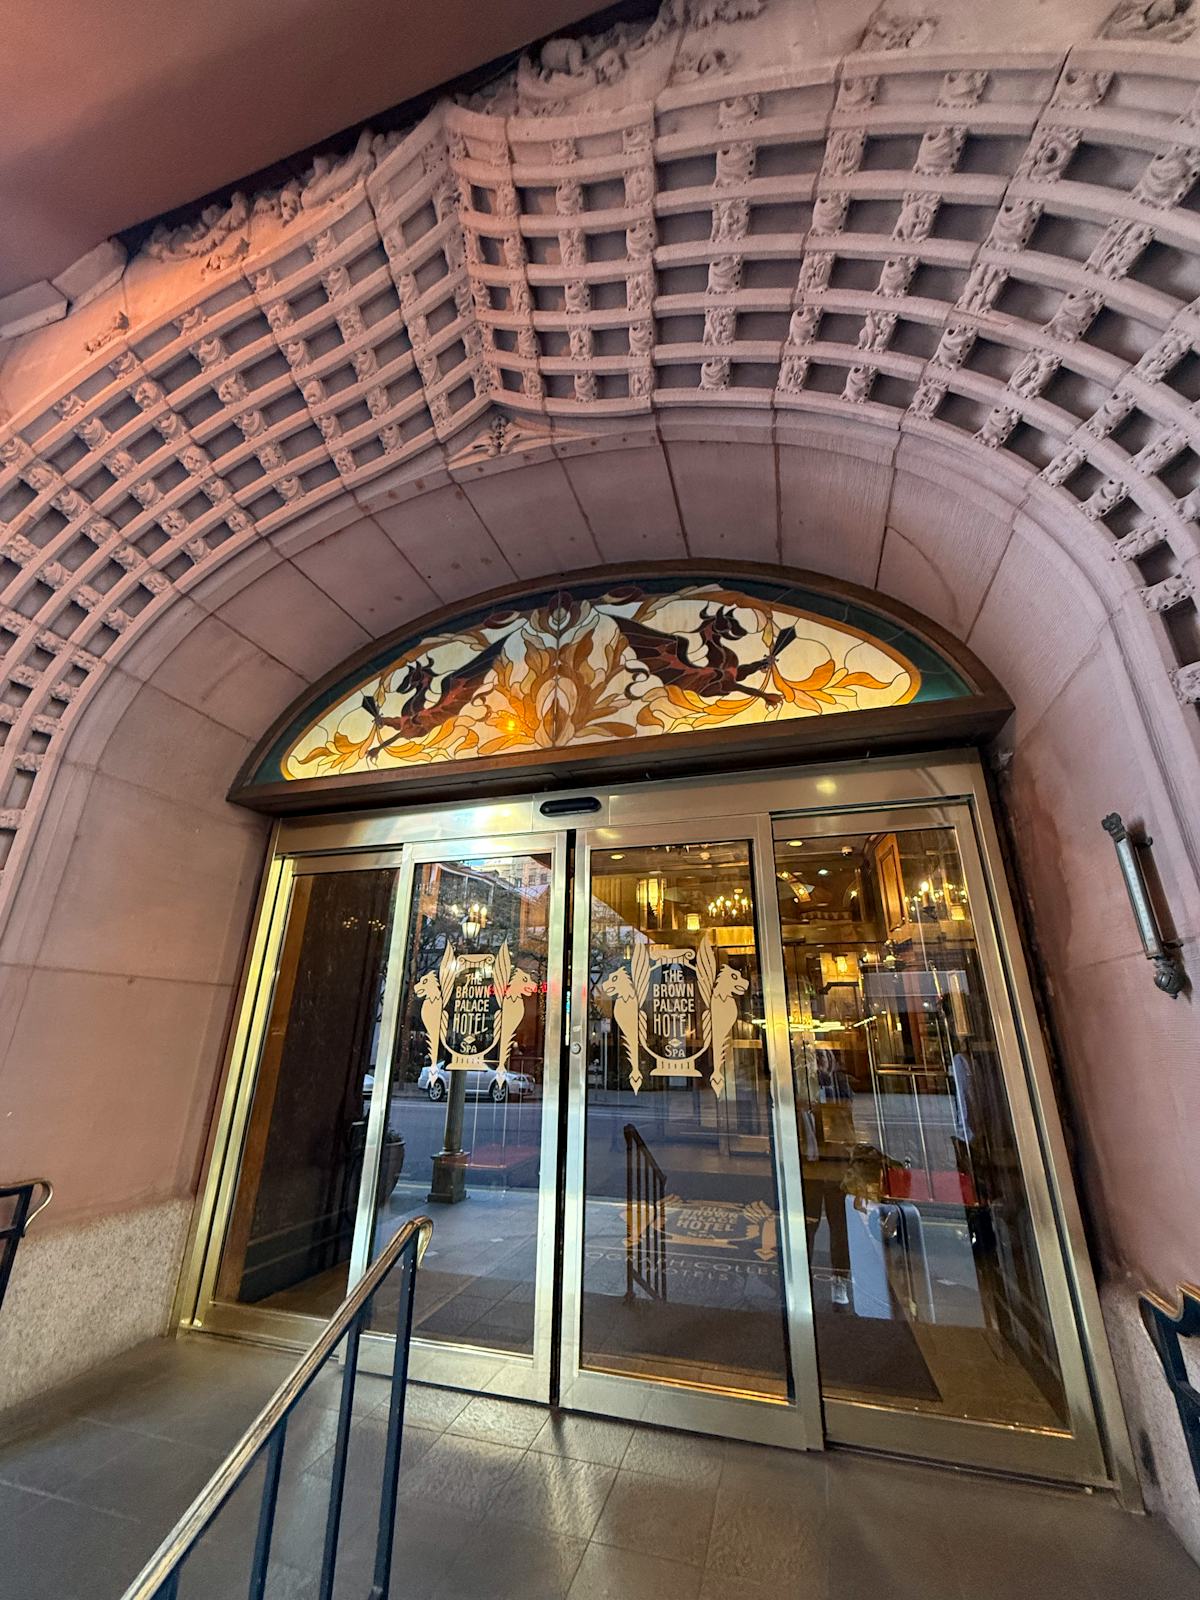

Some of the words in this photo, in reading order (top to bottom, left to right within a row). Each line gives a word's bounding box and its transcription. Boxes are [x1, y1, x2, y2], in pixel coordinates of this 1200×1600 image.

[464, 973, 482, 986] THE
[662, 969, 685, 983] THE
[455, 985, 490, 998] BROWN
[652, 983, 695, 998] BROWN
[454, 999, 490, 1012] PALACE
[653, 998, 695, 1012] PALACE
[452, 1012, 489, 1036] HOTEL
[653, 1013, 696, 1038] HOTEL
[676, 1219, 735, 1232] HOTEL
